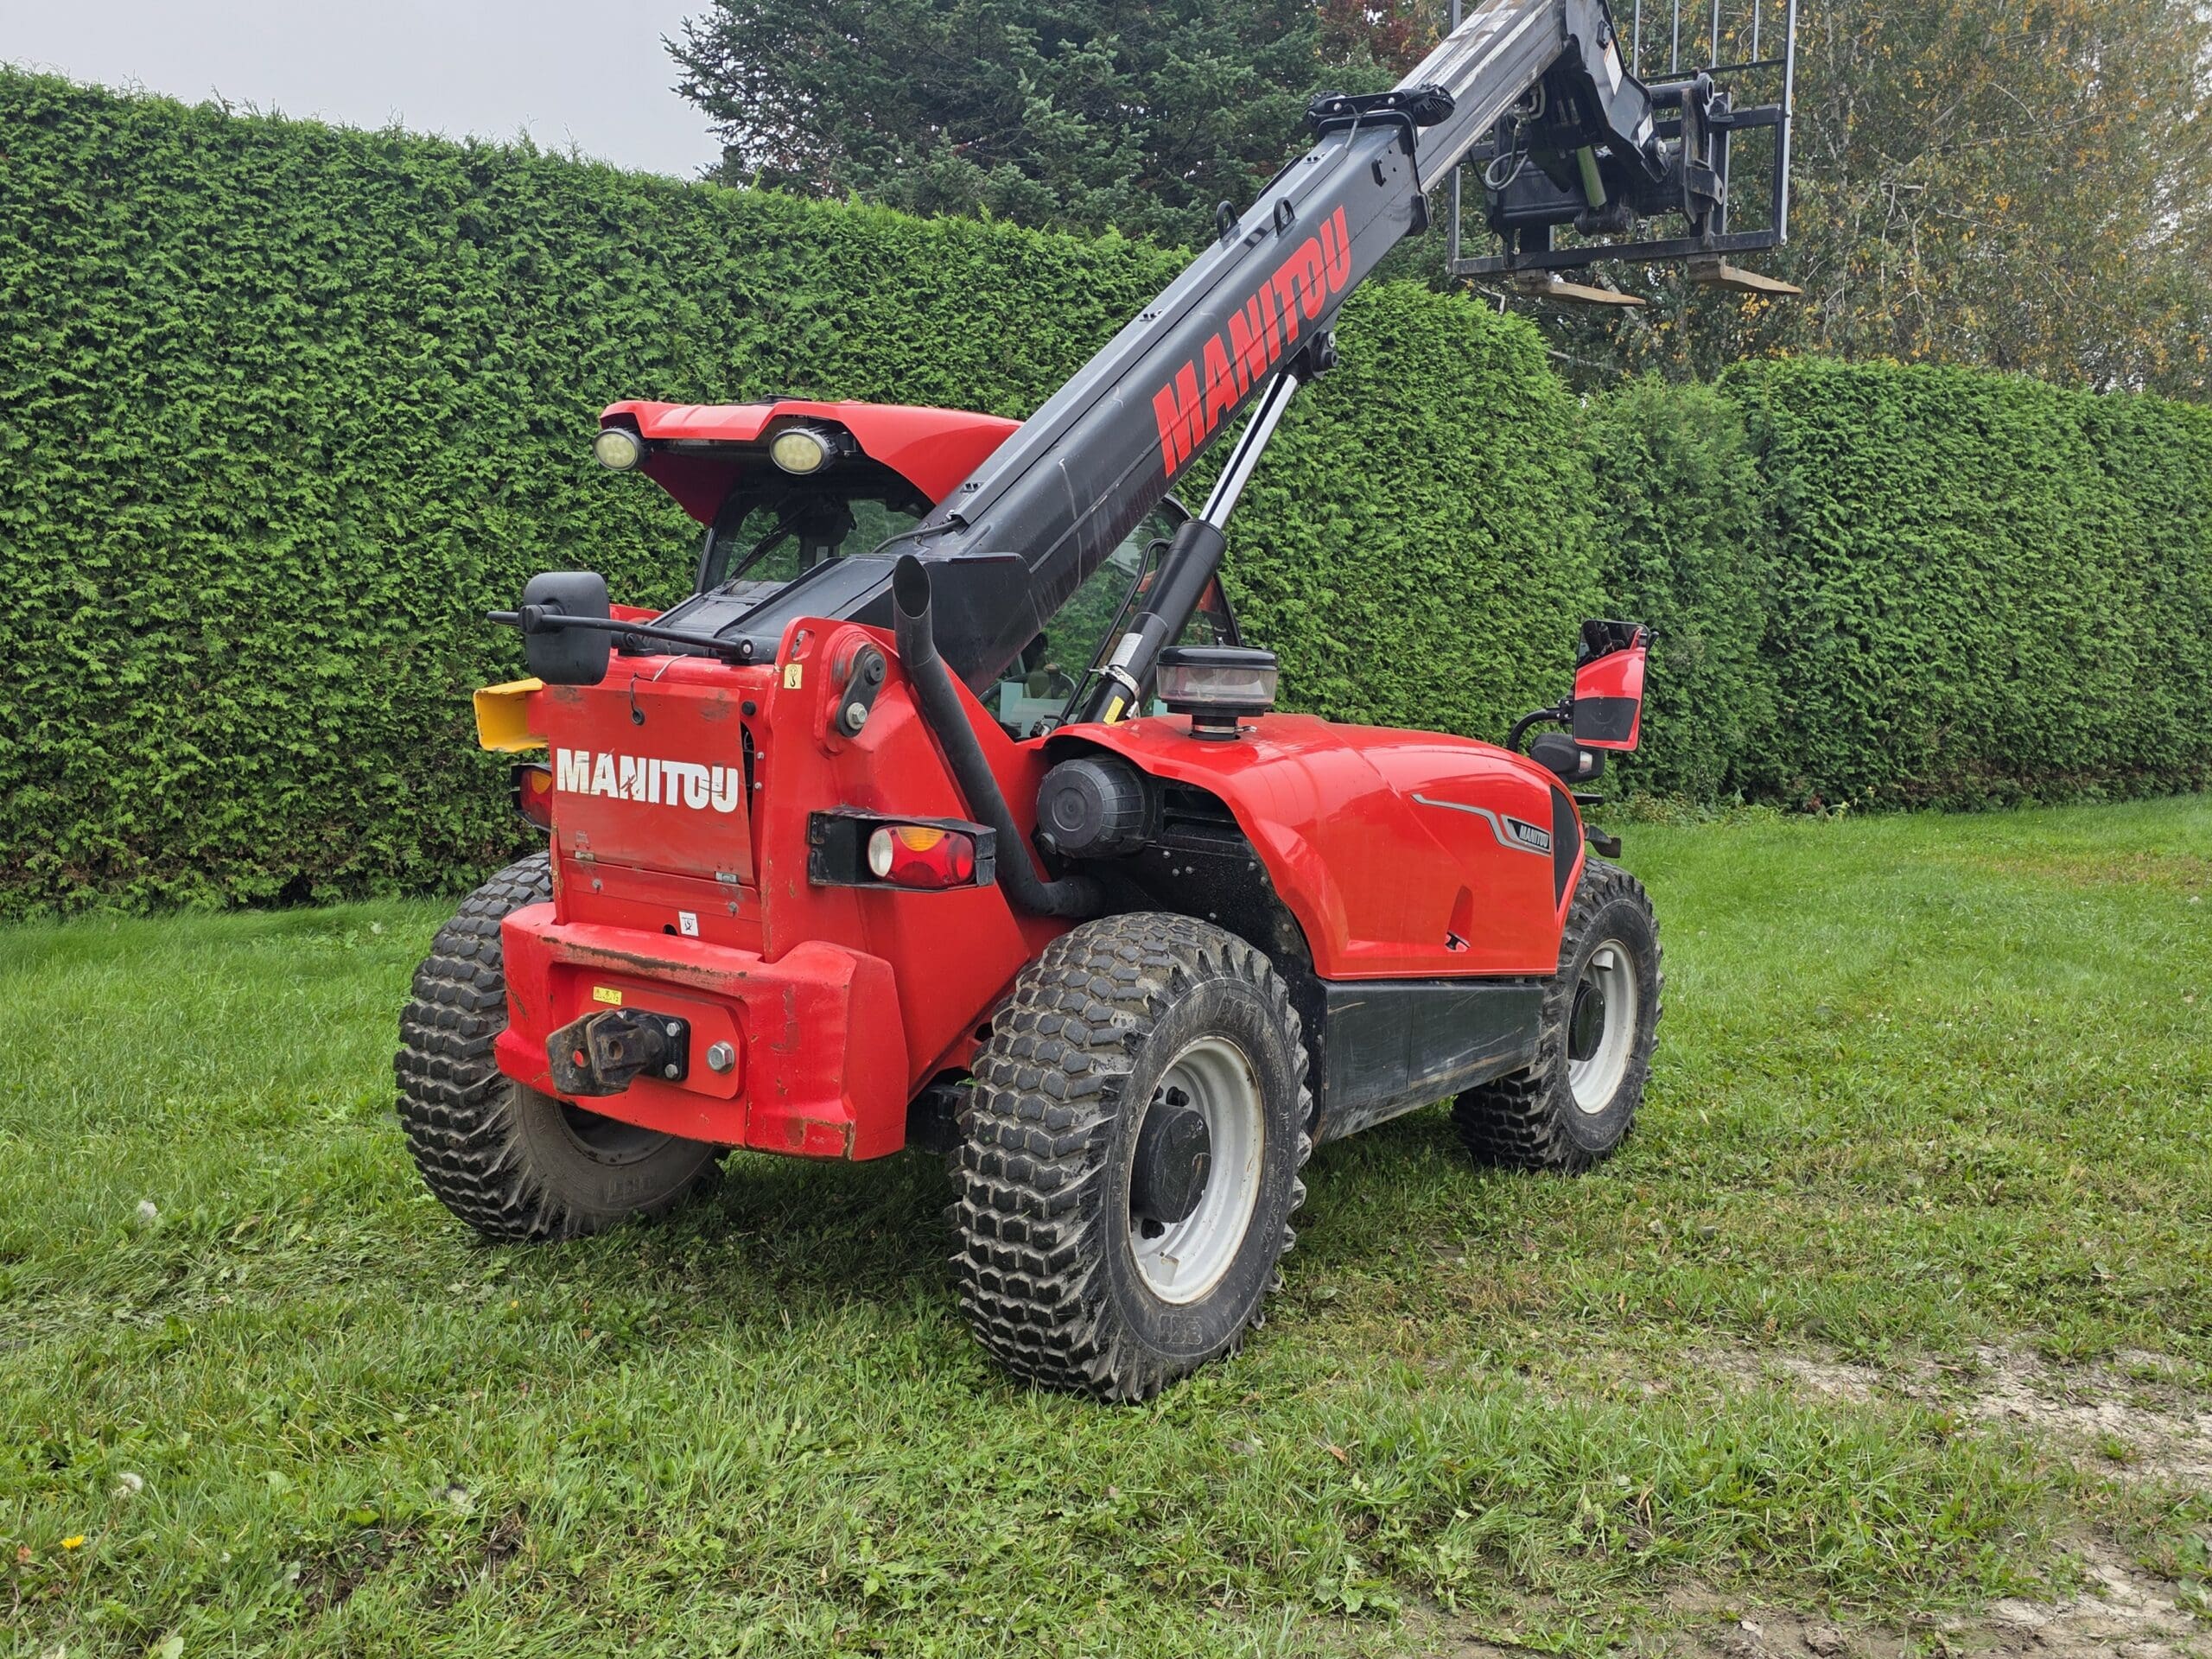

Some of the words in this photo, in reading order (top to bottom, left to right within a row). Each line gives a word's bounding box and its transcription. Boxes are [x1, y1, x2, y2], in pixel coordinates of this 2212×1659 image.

[1152, 205, 1352, 479] MANITOU
[556, 747, 739, 813] MANITOU
[1518, 824, 1549, 848] MANITOU
